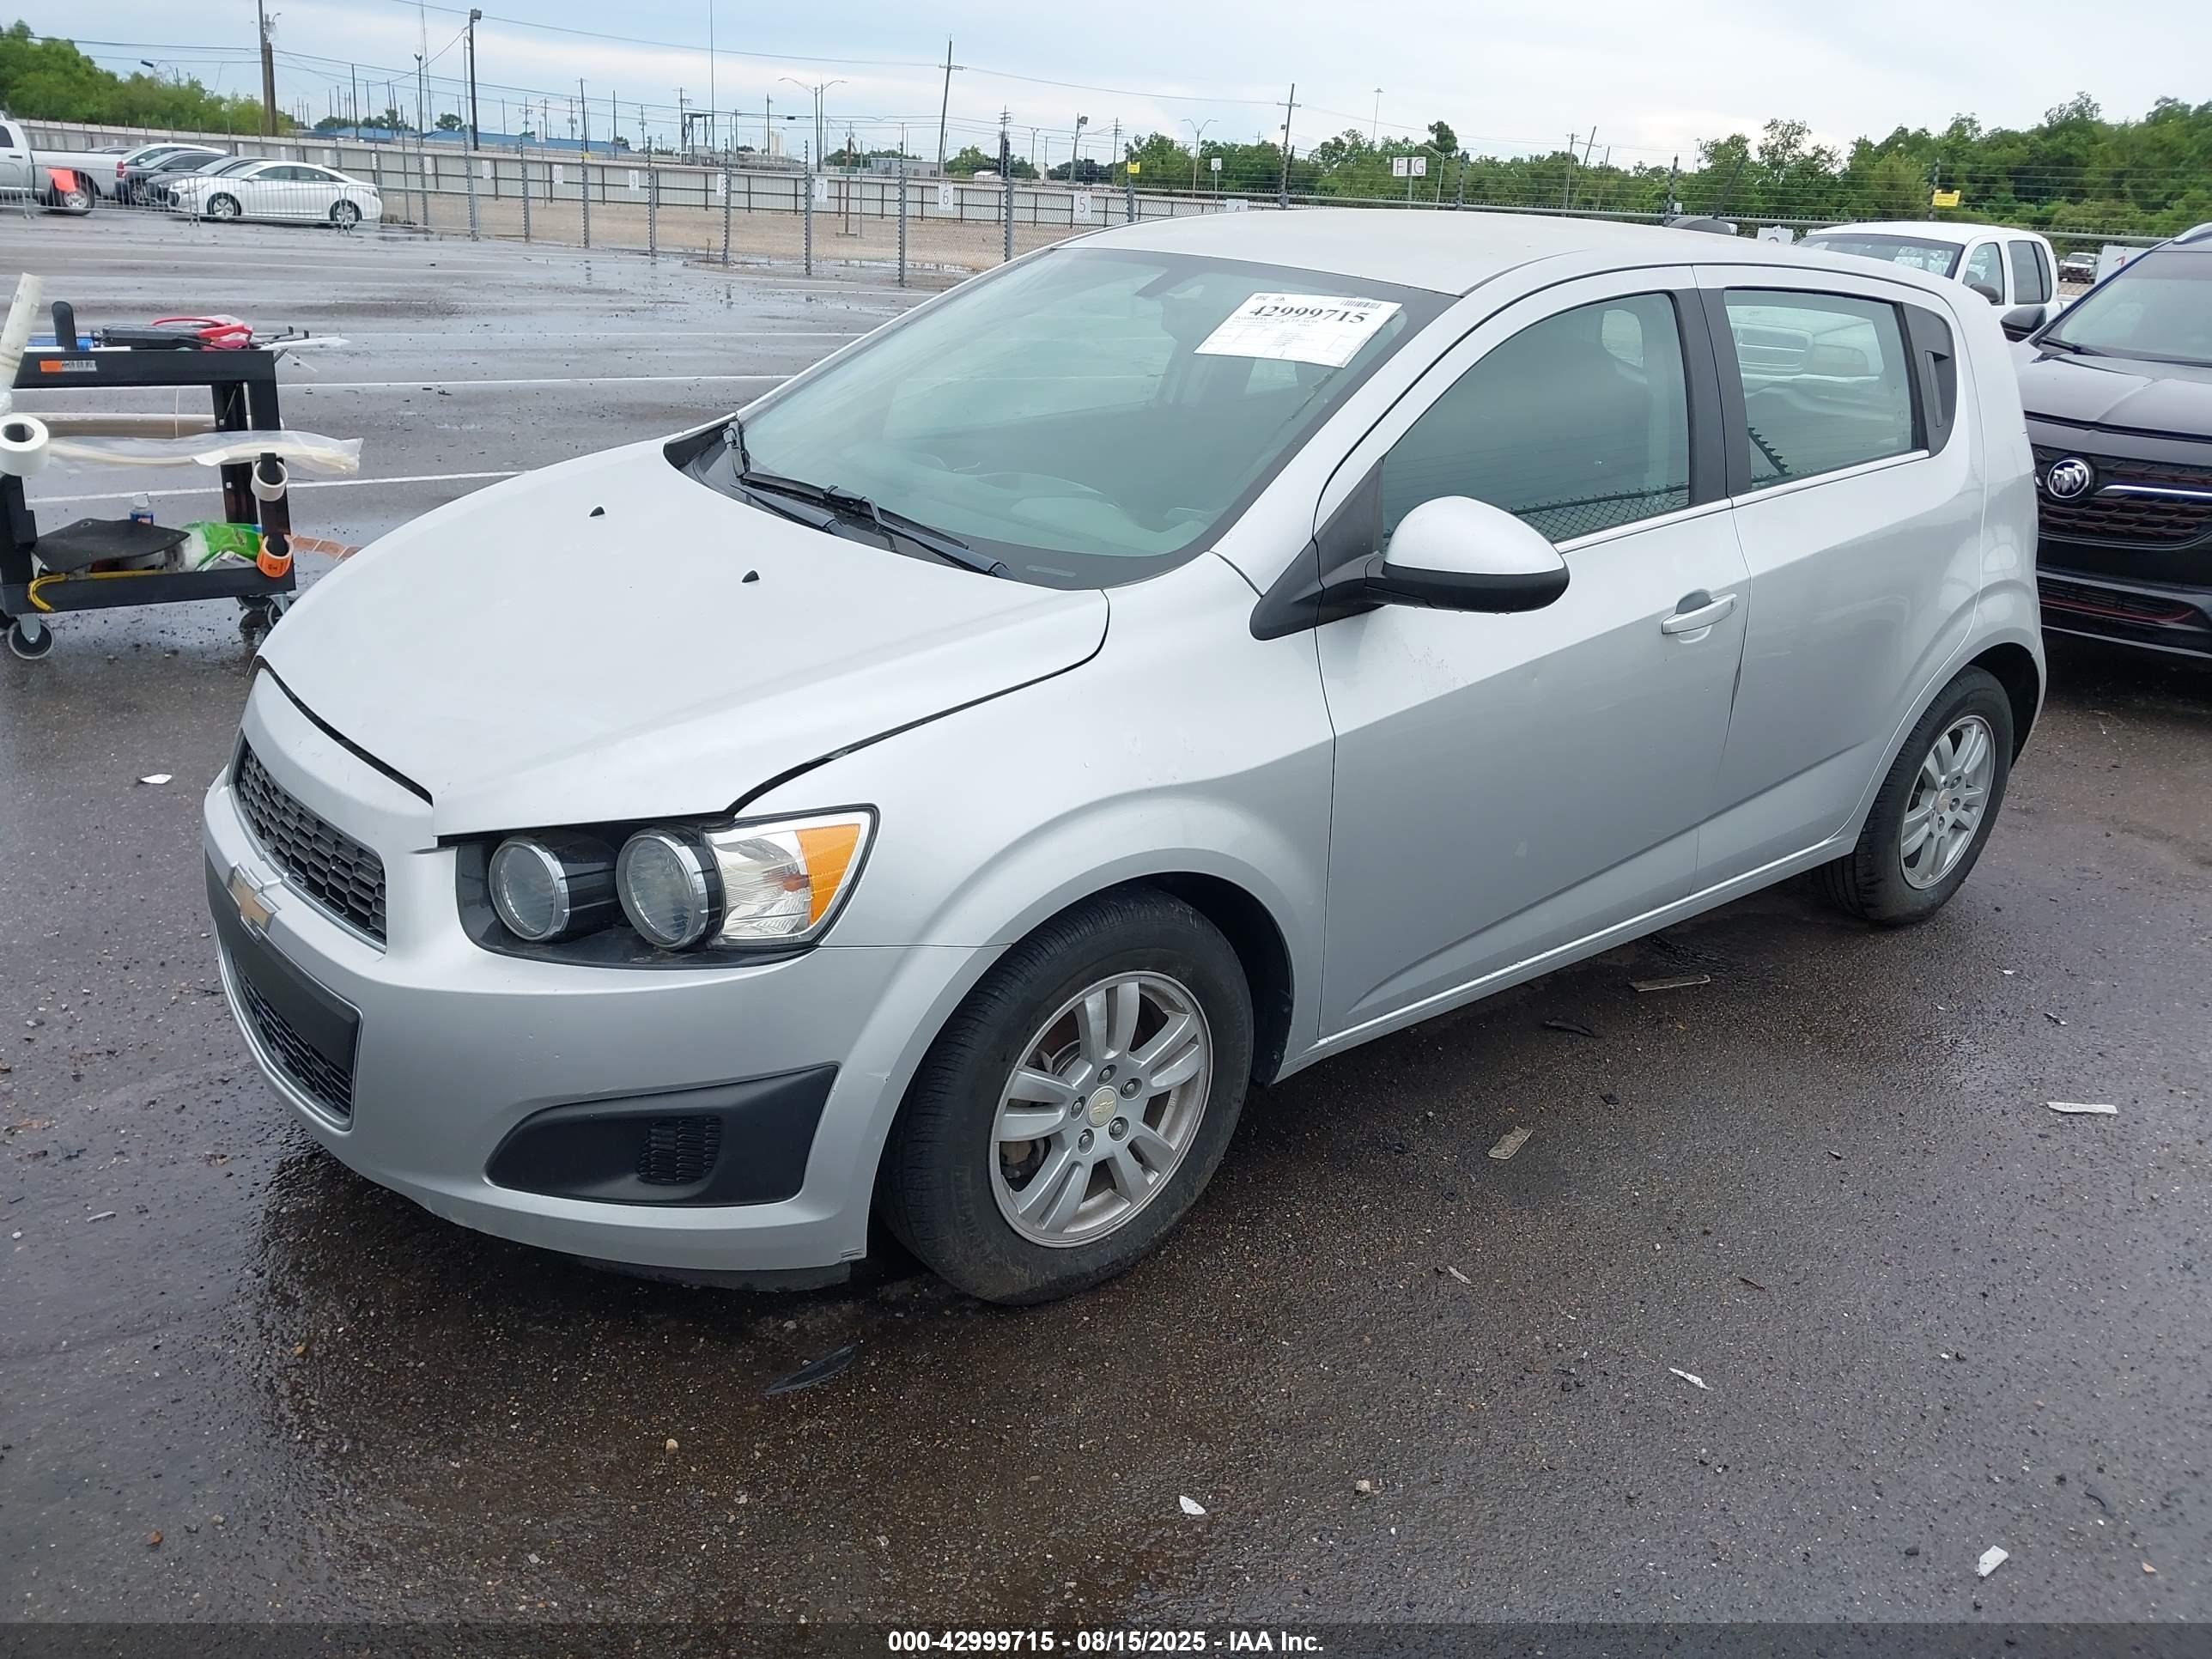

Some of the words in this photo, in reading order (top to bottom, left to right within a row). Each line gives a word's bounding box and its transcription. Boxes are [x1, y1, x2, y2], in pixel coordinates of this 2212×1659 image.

[1396, 159, 1404, 174] F
[1413, 159, 1425, 174] G
[631, 174, 636, 186] 9
[720, 178, 726, 192] 8
[818, 183, 824, 198] 7
[943, 189, 949, 205] 6
[1079, 197, 1086, 213] 5
[1249, 306, 1370, 323] 42999715
